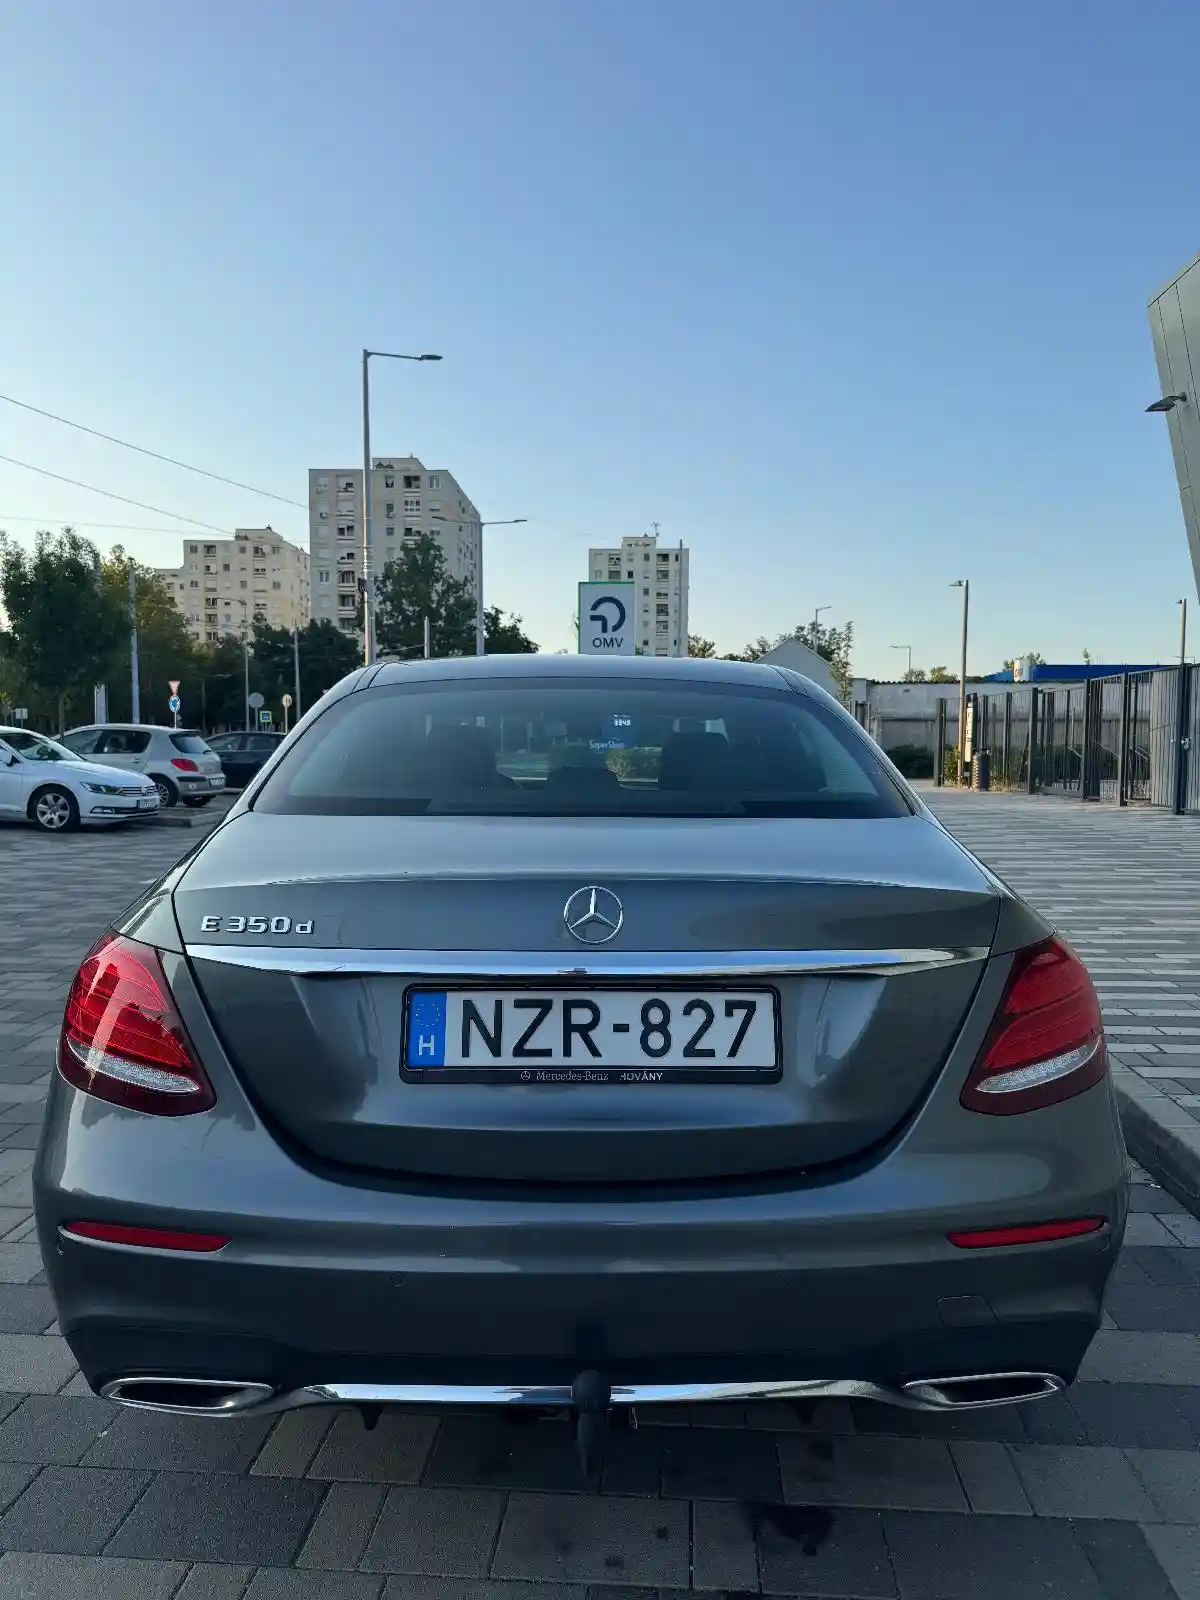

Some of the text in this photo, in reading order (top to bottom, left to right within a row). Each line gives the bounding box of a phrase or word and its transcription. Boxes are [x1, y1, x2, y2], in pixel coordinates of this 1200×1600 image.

[592, 636, 624, 649] OMV
[200, 915, 315, 934] E 350 d
[460, 997, 757, 1059] NZR-827
[418, 1034, 435, 1056] H
[536, 1070, 609, 1081] Mercedes-Benz
